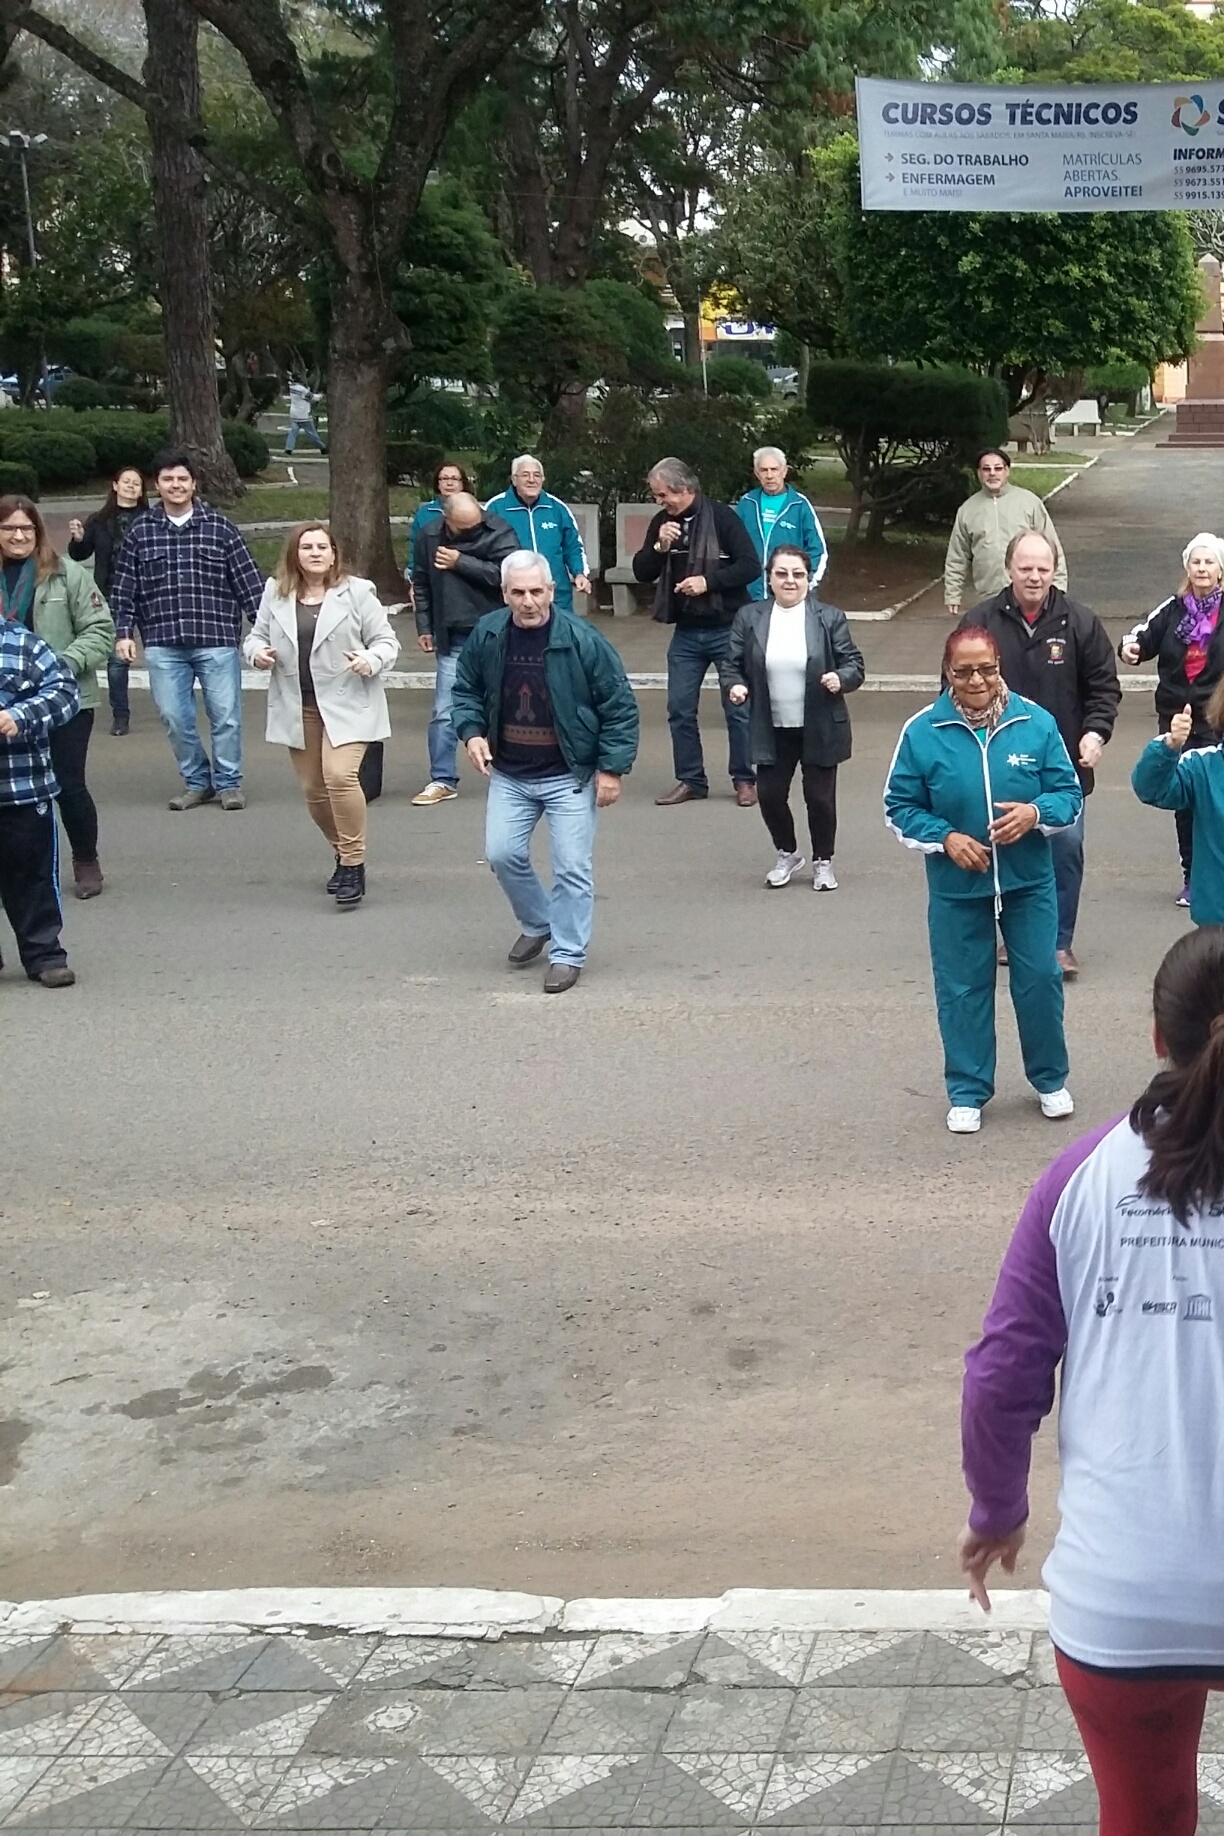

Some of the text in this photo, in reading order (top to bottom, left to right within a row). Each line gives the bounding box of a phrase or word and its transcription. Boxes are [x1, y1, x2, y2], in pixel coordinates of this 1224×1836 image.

[882, 98, 1138, 126] CURSOS TÉCNICOS
[1026, 131, 1050, 139] SANTA
[901, 152, 1029, 167] SEG. DO TRABALHO
[1062, 151, 1143, 166] MATRÍCULAS
[901, 172, 996, 186] ENFERMAGEM
[910, 188, 937, 197] MUITO
[1064, 185, 1143, 198] APROVEITE!
